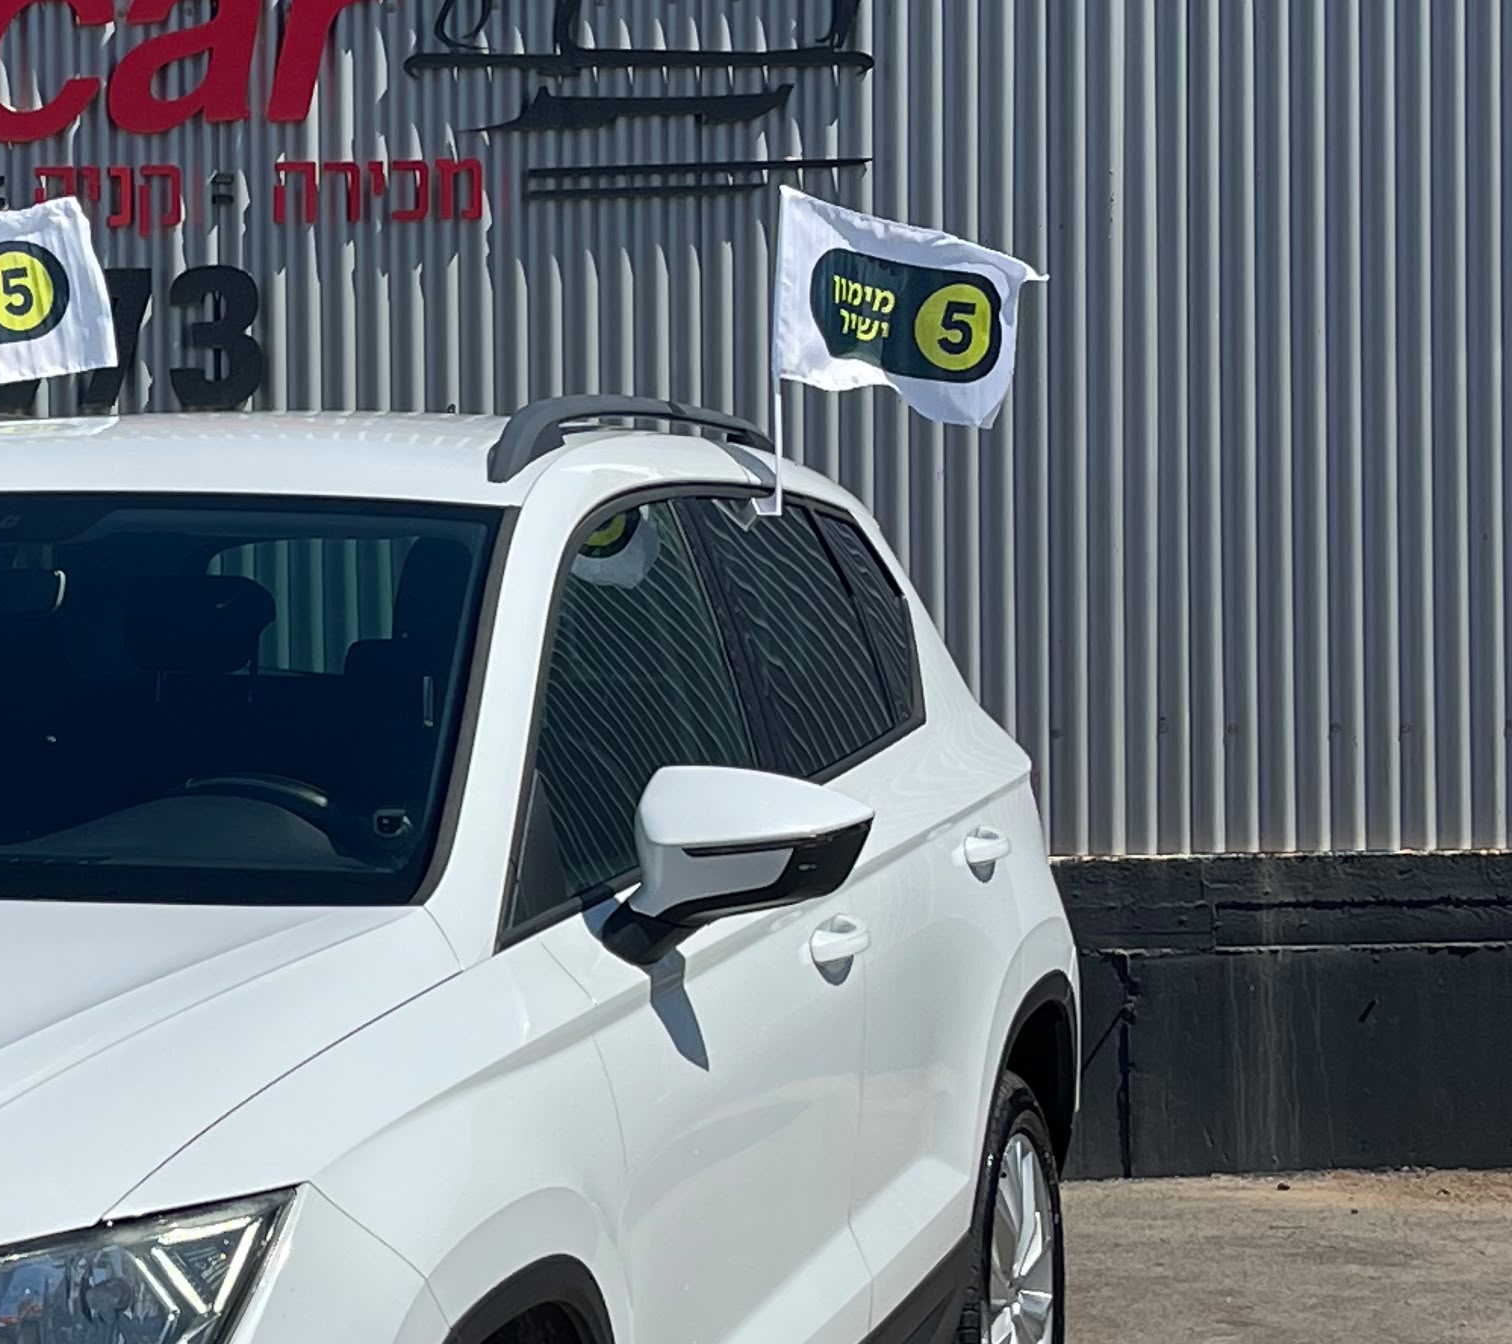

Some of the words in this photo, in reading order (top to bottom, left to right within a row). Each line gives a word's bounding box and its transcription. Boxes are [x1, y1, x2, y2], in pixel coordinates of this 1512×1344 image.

[274, 158, 484, 224] מכירה
[1, 266, 34, 316] 5
[832, 274, 896, 314] מימון
[839, 308, 891, 342] ישיר
[937, 300, 977, 355] 5
